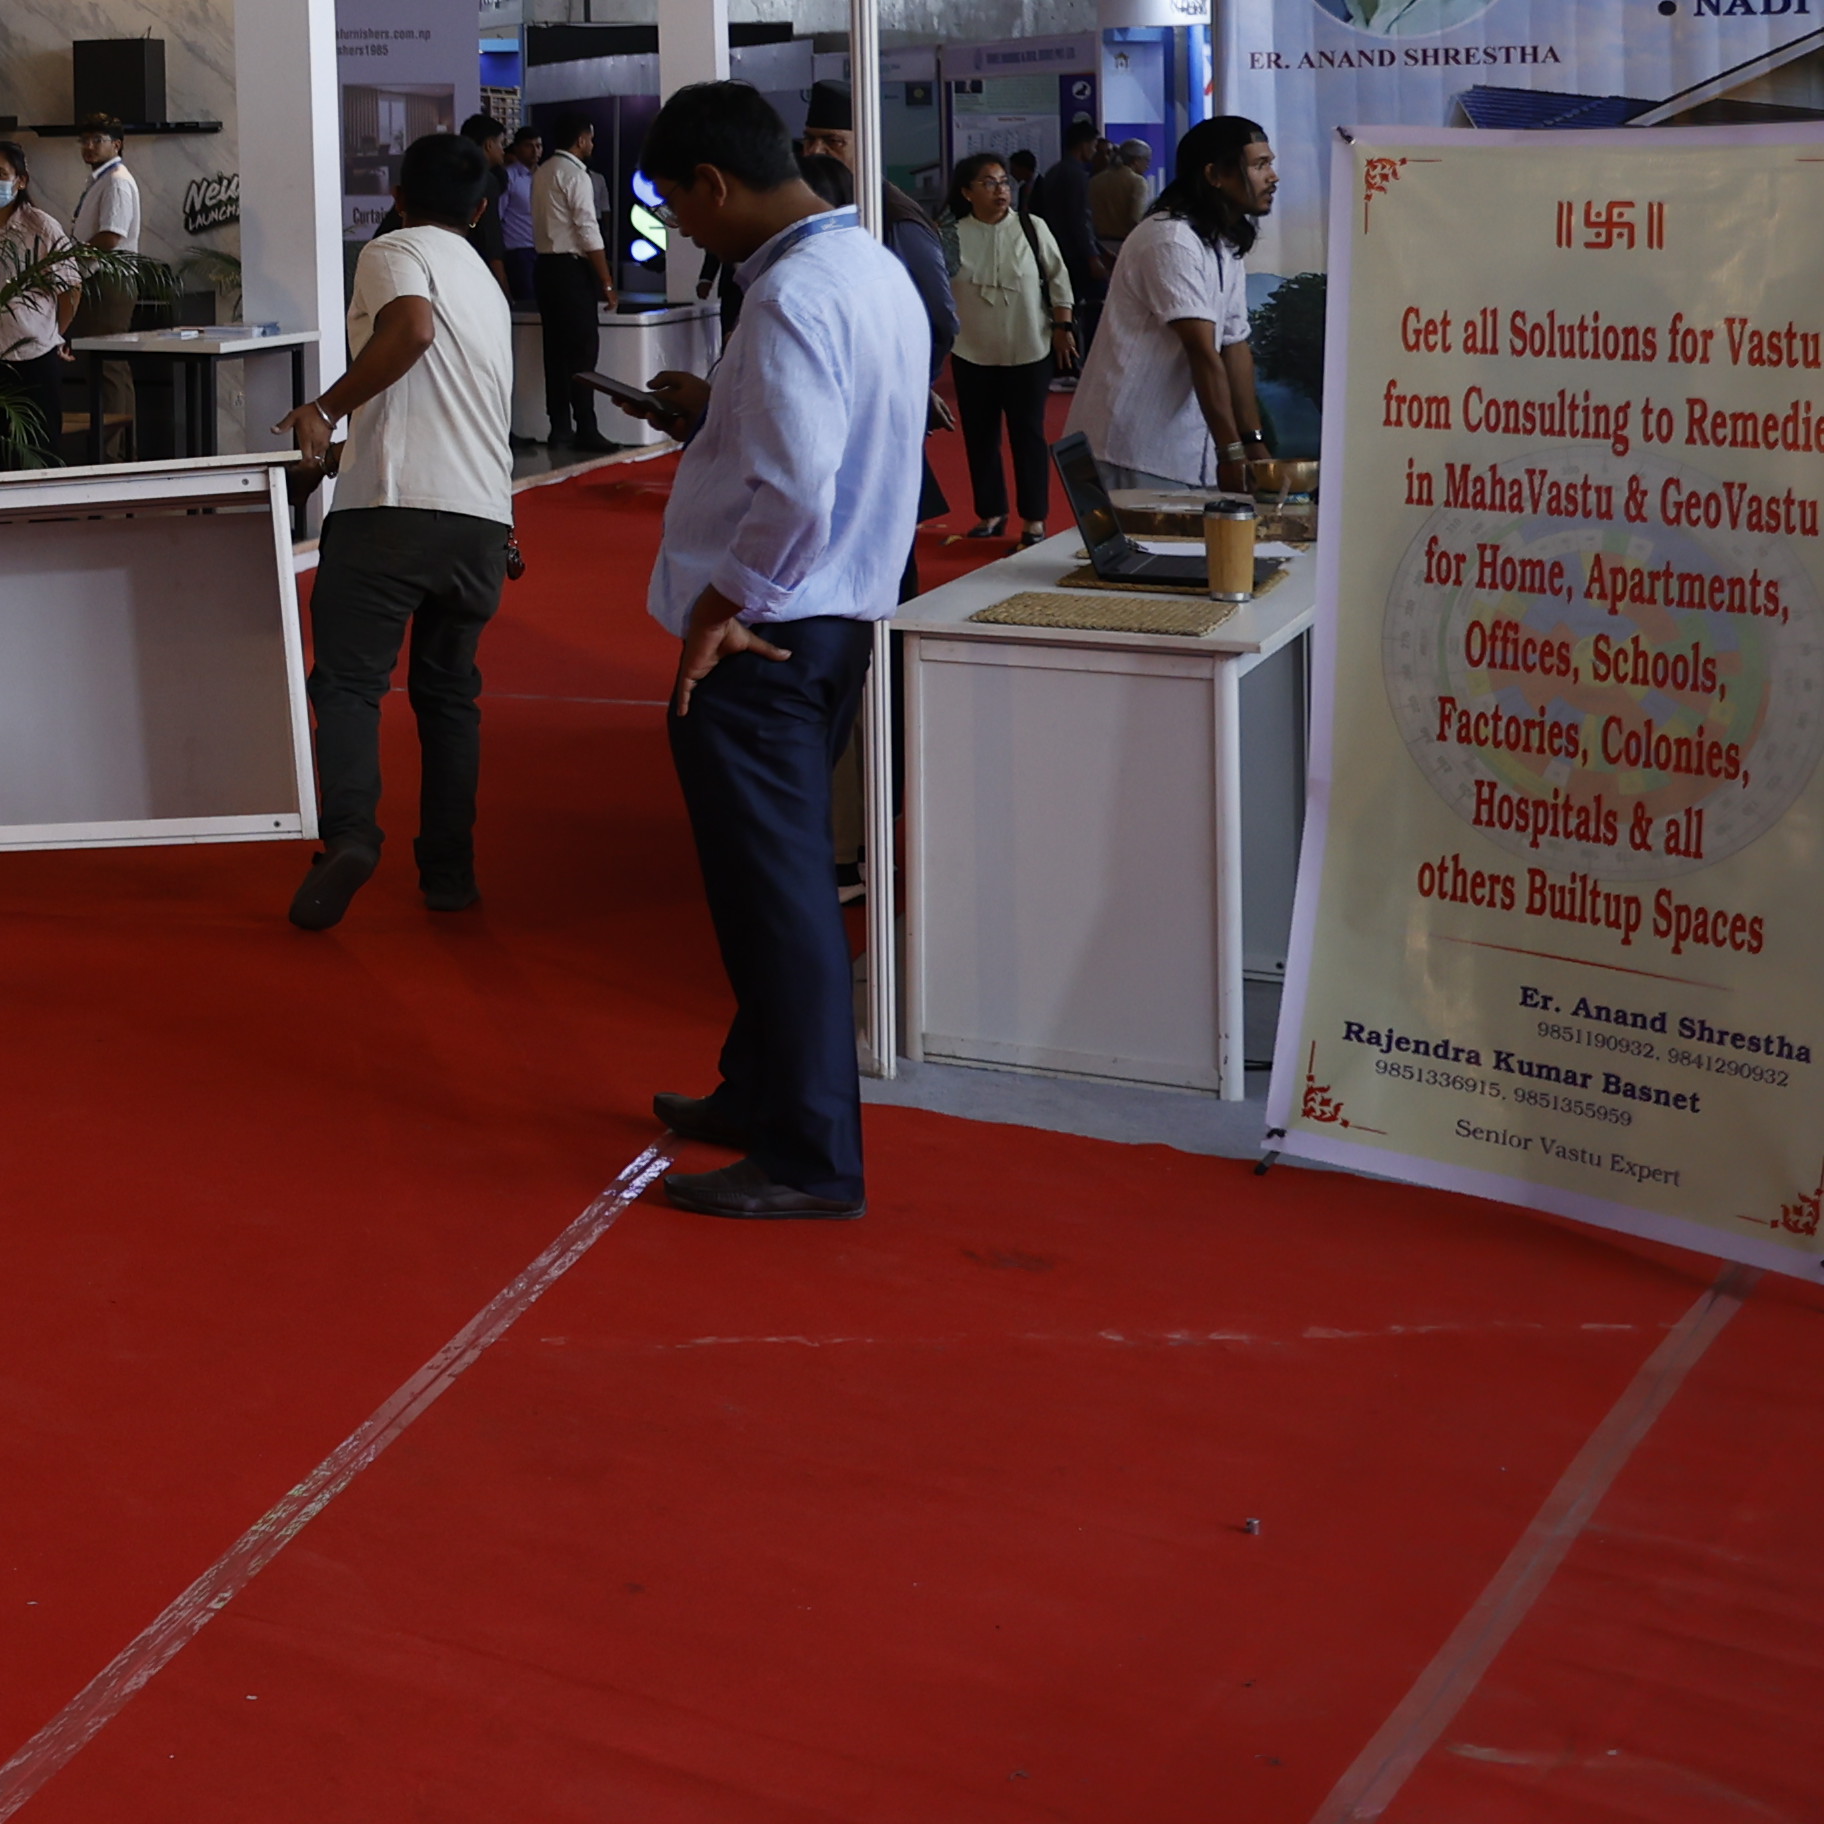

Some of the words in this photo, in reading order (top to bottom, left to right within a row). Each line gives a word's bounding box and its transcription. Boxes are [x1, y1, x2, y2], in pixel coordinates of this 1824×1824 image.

[1249, 51, 1290, 71] ER.
[1297, 48, 1397, 69] ANAND
[1404, 44, 1561, 67] SHRESTHA
[1402, 307, 1451, 353] Get
[1463, 307, 1498, 355] all
[1510, 310, 1657, 361] Solutions
[1668, 312, 1714, 364] for
[1725, 317, 1822, 369] Vastu
[1383, 379, 1451, 430] from
[1463, 386, 1631, 457] Consulting
[1642, 397, 1674, 443] to
[1405, 458, 1433, 506] in
[1444, 463, 1613, 520] MahaVastu
[1624, 475, 1648, 523] &
[1661, 477, 1818, 536] GeoVastu
[1425, 536, 1467, 585] for
[1476, 543, 1573, 604] Home,
[1584, 554, 1789, 623] Apartments,
[1465, 619, 1580, 684] Offices,
[1593, 634, 1726, 701] Schools,
[1436, 695, 1588, 766] Factories,
[1602, 715, 1749, 787] Colonies,
[1472, 779, 1618, 849] Hospitals
[1630, 801, 1654, 851] &
[1665, 807, 1704, 859] all
[1418, 854, 1515, 911] others
[1526, 868, 1642, 945] Builtup
[1653, 888, 1764, 954] Spaces
[1518, 985, 1561, 1014] Er.
[1570, 996, 1668, 1035] Anand
[1677, 1016, 1812, 1065] Shrestha
[1342, 1020, 1483, 1068] Rajendra
[1492, 1049, 1593, 1090] Kumar
[1601, 1072, 1702, 1114] Basnet
[1667, 1046, 1790, 1088] 9841290932
[1512, 1086, 1633, 1128] 9851355959
[1455, 1118, 1534, 1152] Senior
[1539, 1136, 1603, 1168] Vastu
[1609, 1153, 1682, 1188] Expert
